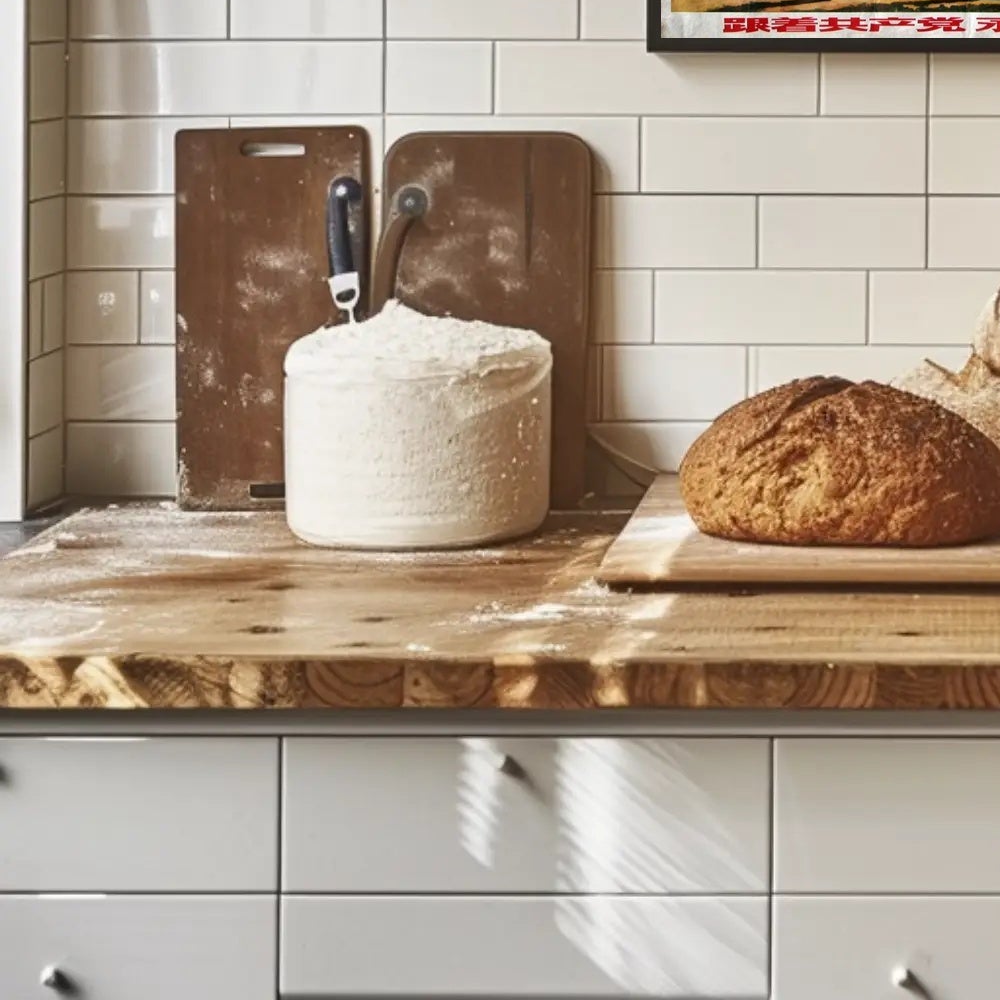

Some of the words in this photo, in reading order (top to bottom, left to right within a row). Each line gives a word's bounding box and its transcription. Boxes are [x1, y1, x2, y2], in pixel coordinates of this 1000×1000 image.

[723, 16, 966, 34] 跟着共产党
